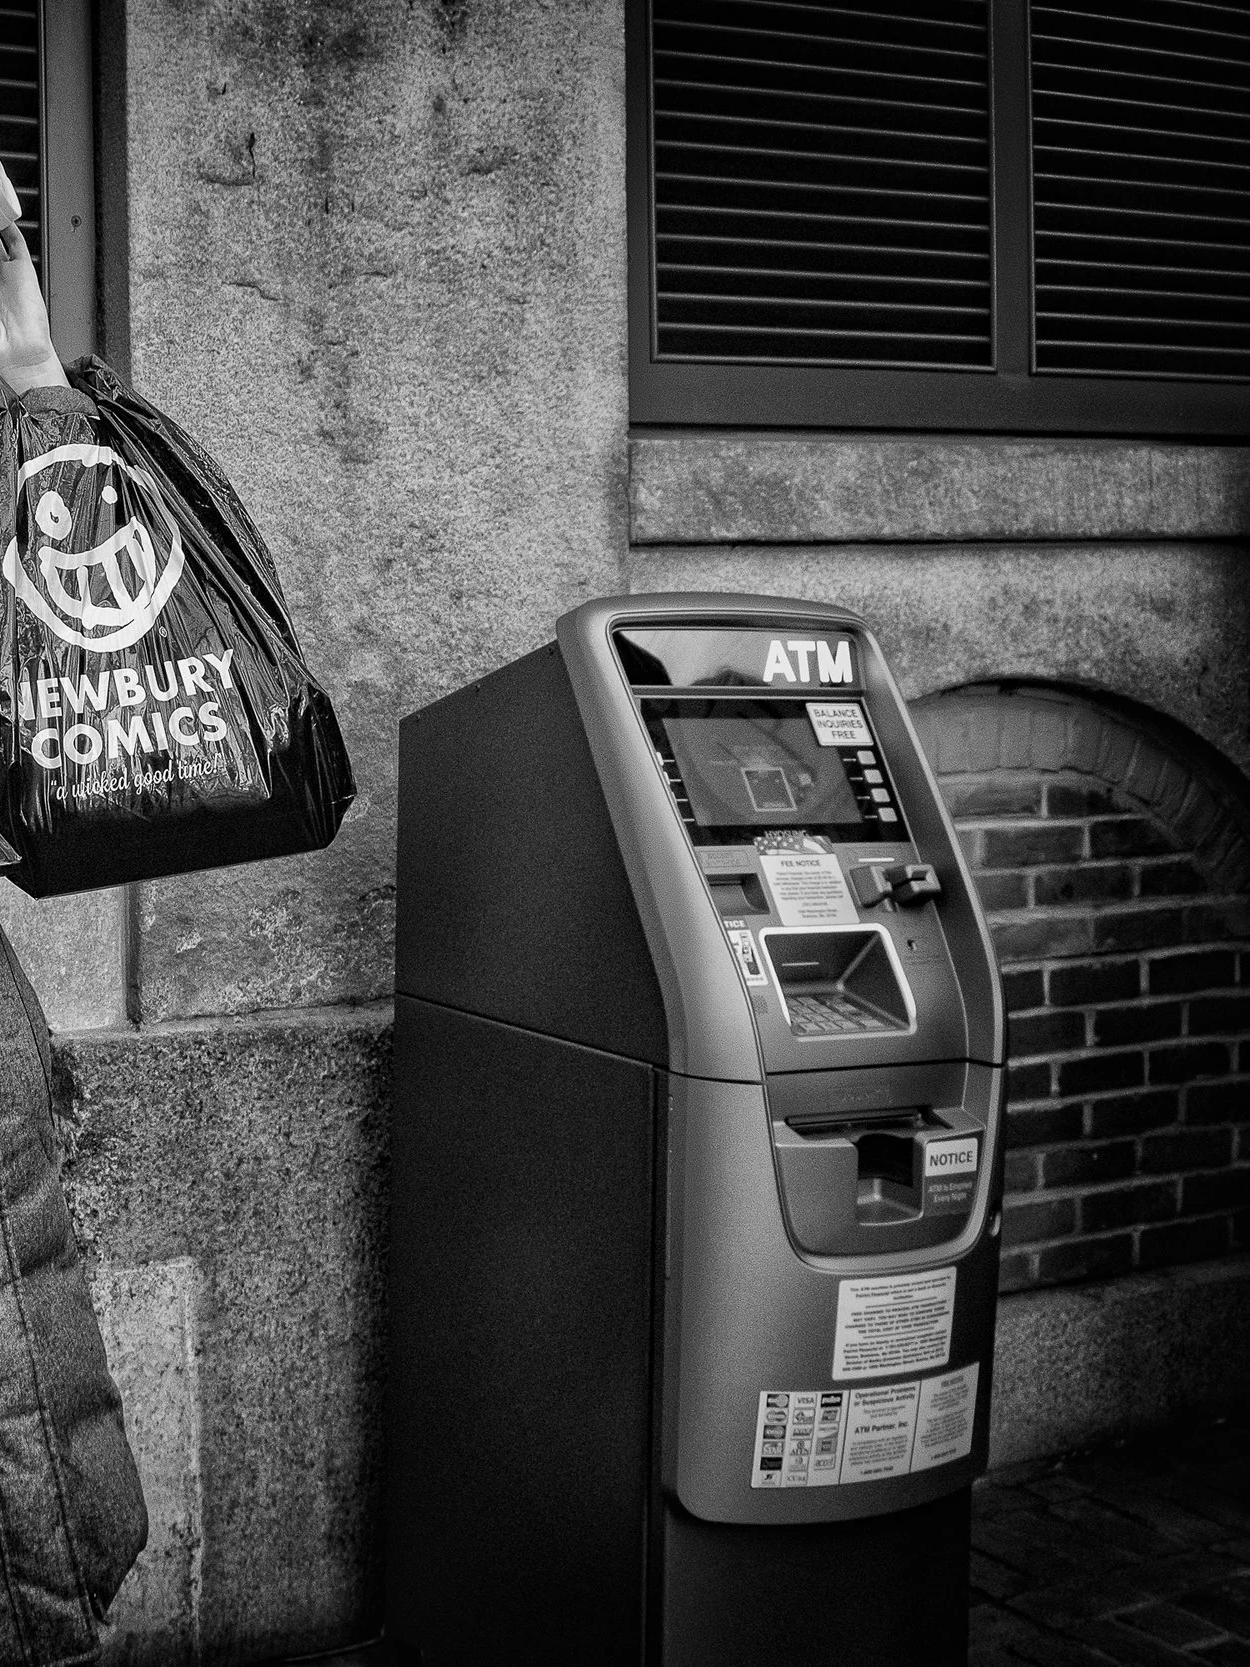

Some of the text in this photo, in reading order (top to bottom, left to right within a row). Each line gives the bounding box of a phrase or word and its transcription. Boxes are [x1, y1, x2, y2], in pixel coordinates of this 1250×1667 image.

[763, 640, 853, 683] ATM
[18, 648, 234, 722] NEWBURY
[813, 708, 859, 719] BALANCE
[816, 719, 864, 729] INQUIRIES
[31, 701, 228, 770] COMICS
[831, 730, 858, 740] FREE
[72, 766, 131, 797] wicked
[134, 759, 175, 796] good
[780, 859, 821, 868] FEE NOTICE
[723, 919, 746, 929] TICE
[929, 1150, 973, 1167] NOTICE
[797, 1397, 815, 1405] VISA
[854, 1426, 870, 1434] ATM
